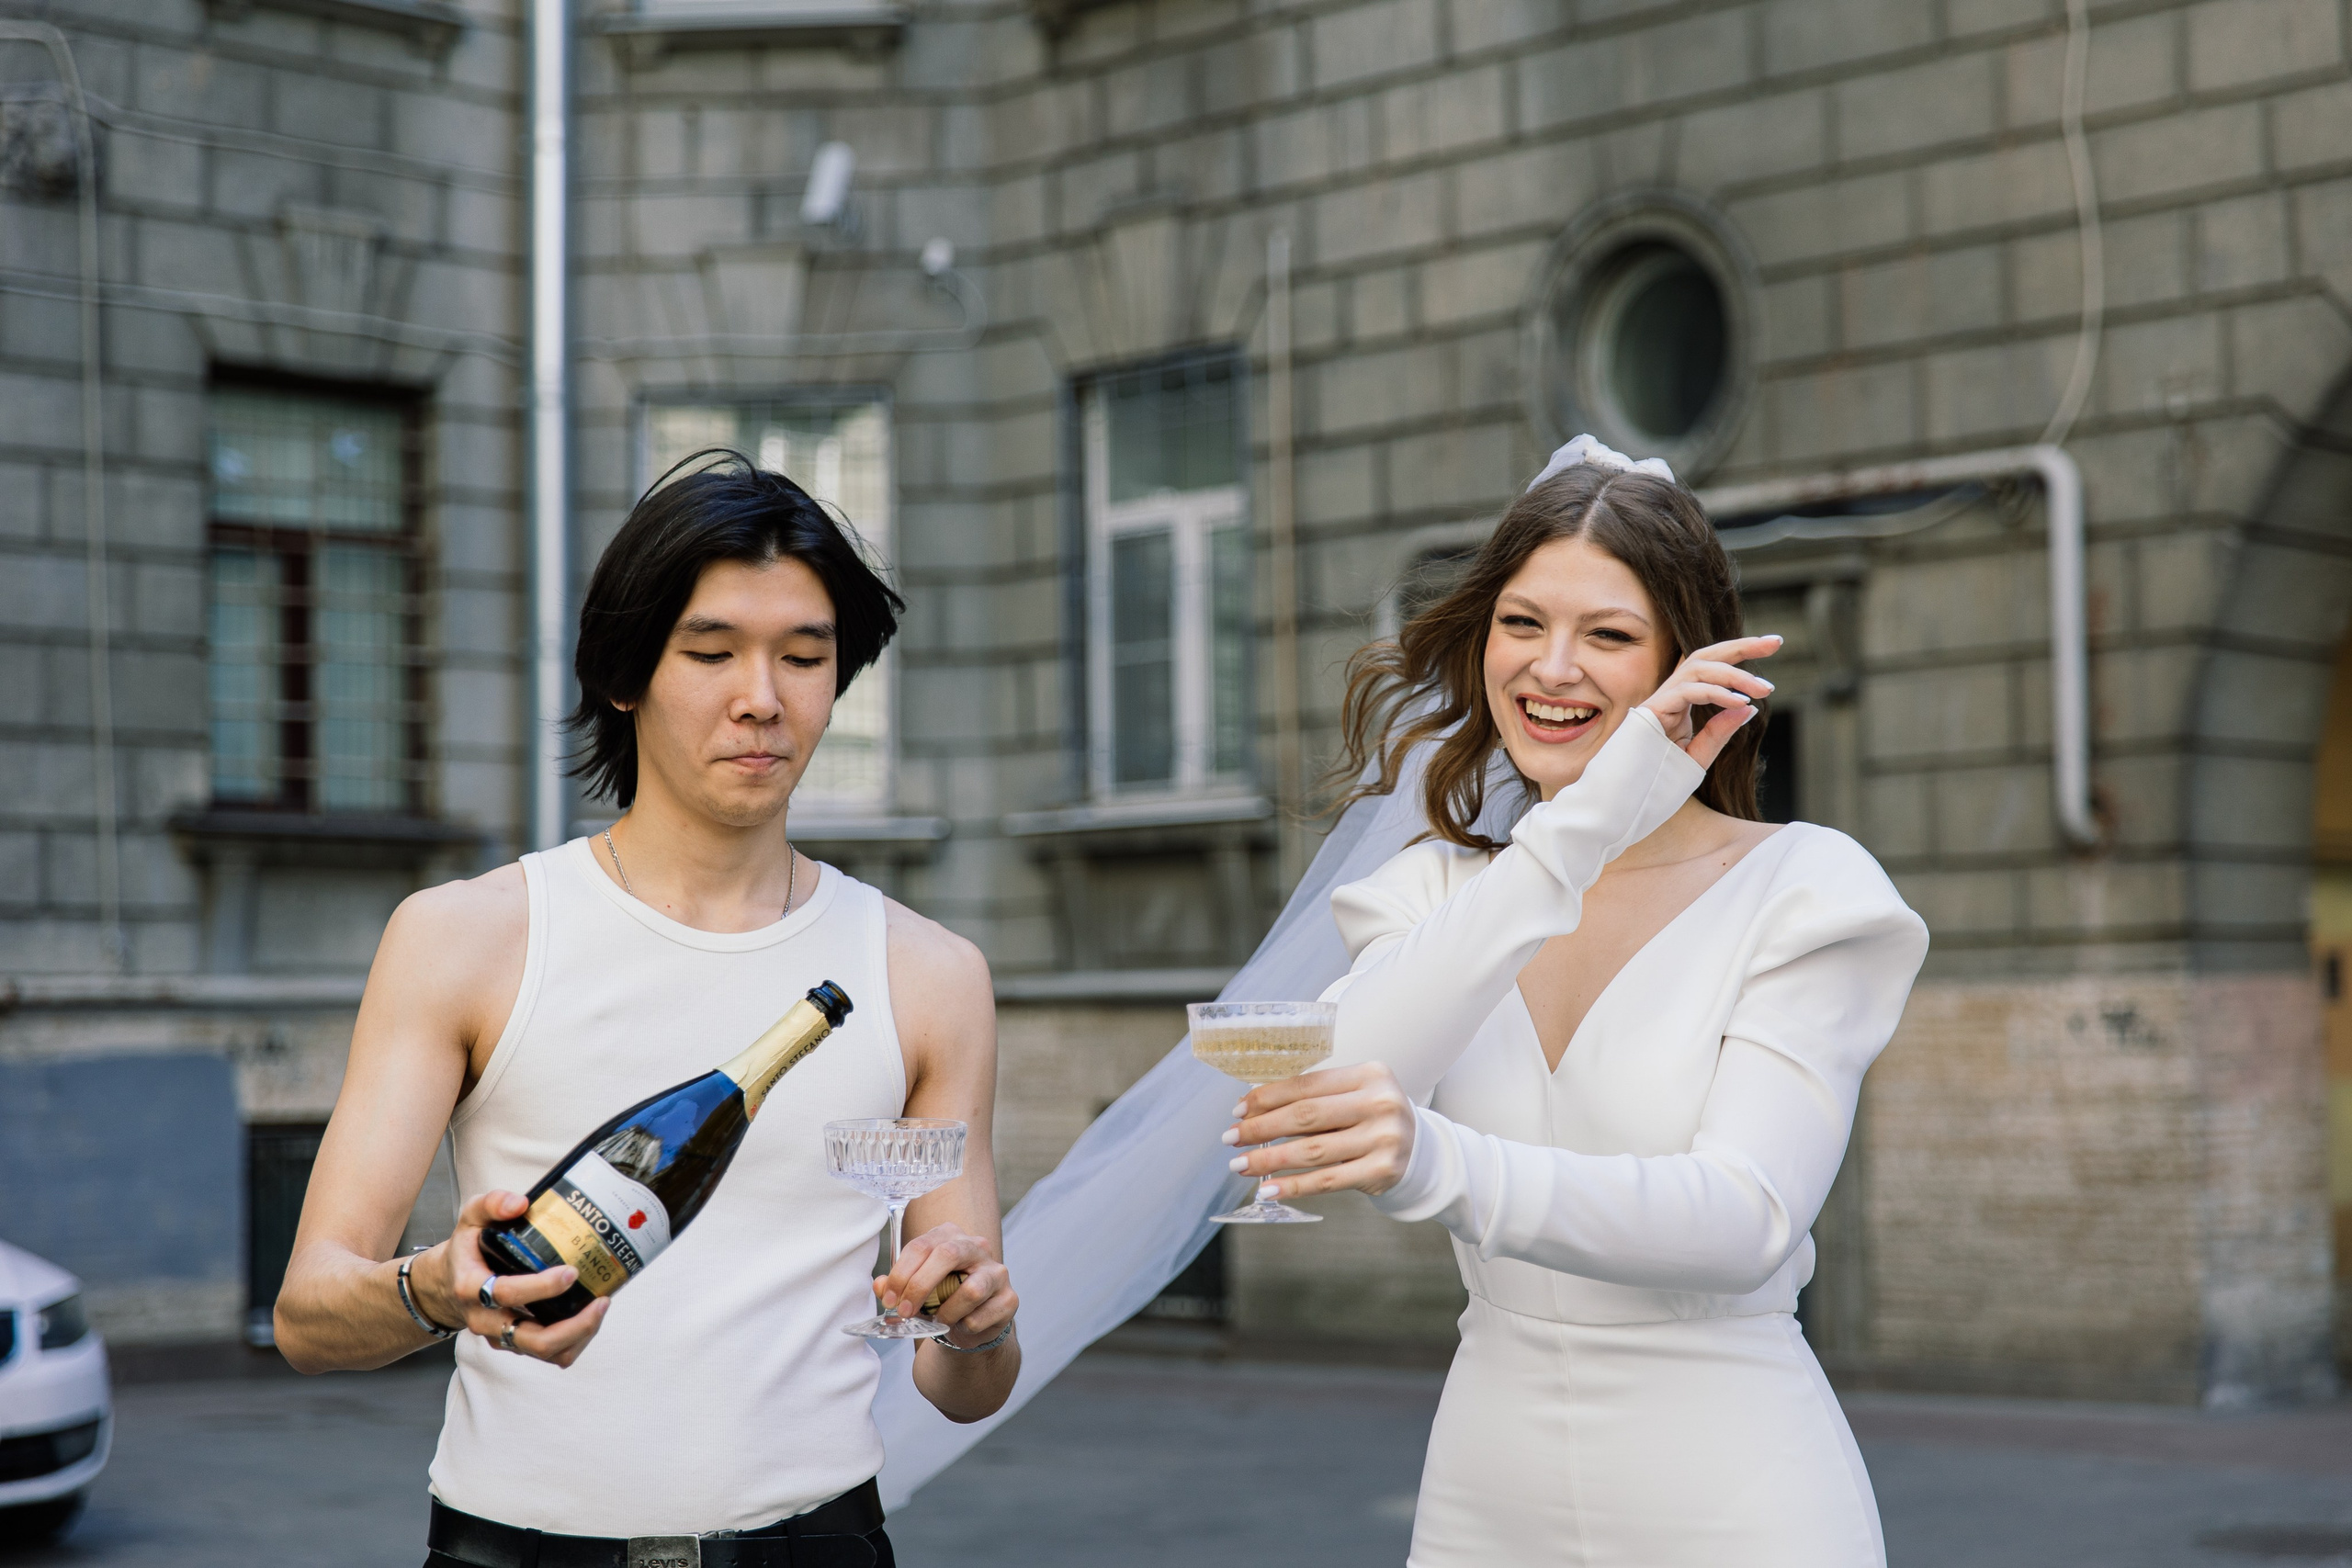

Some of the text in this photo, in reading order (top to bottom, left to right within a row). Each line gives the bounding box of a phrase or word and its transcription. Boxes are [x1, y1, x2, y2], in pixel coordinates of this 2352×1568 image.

[761, 1028, 830, 1098] SANTO STEFANO
[567, 1190, 610, 1233] SANTO
[571, 1235, 612, 1282] BIANCO
